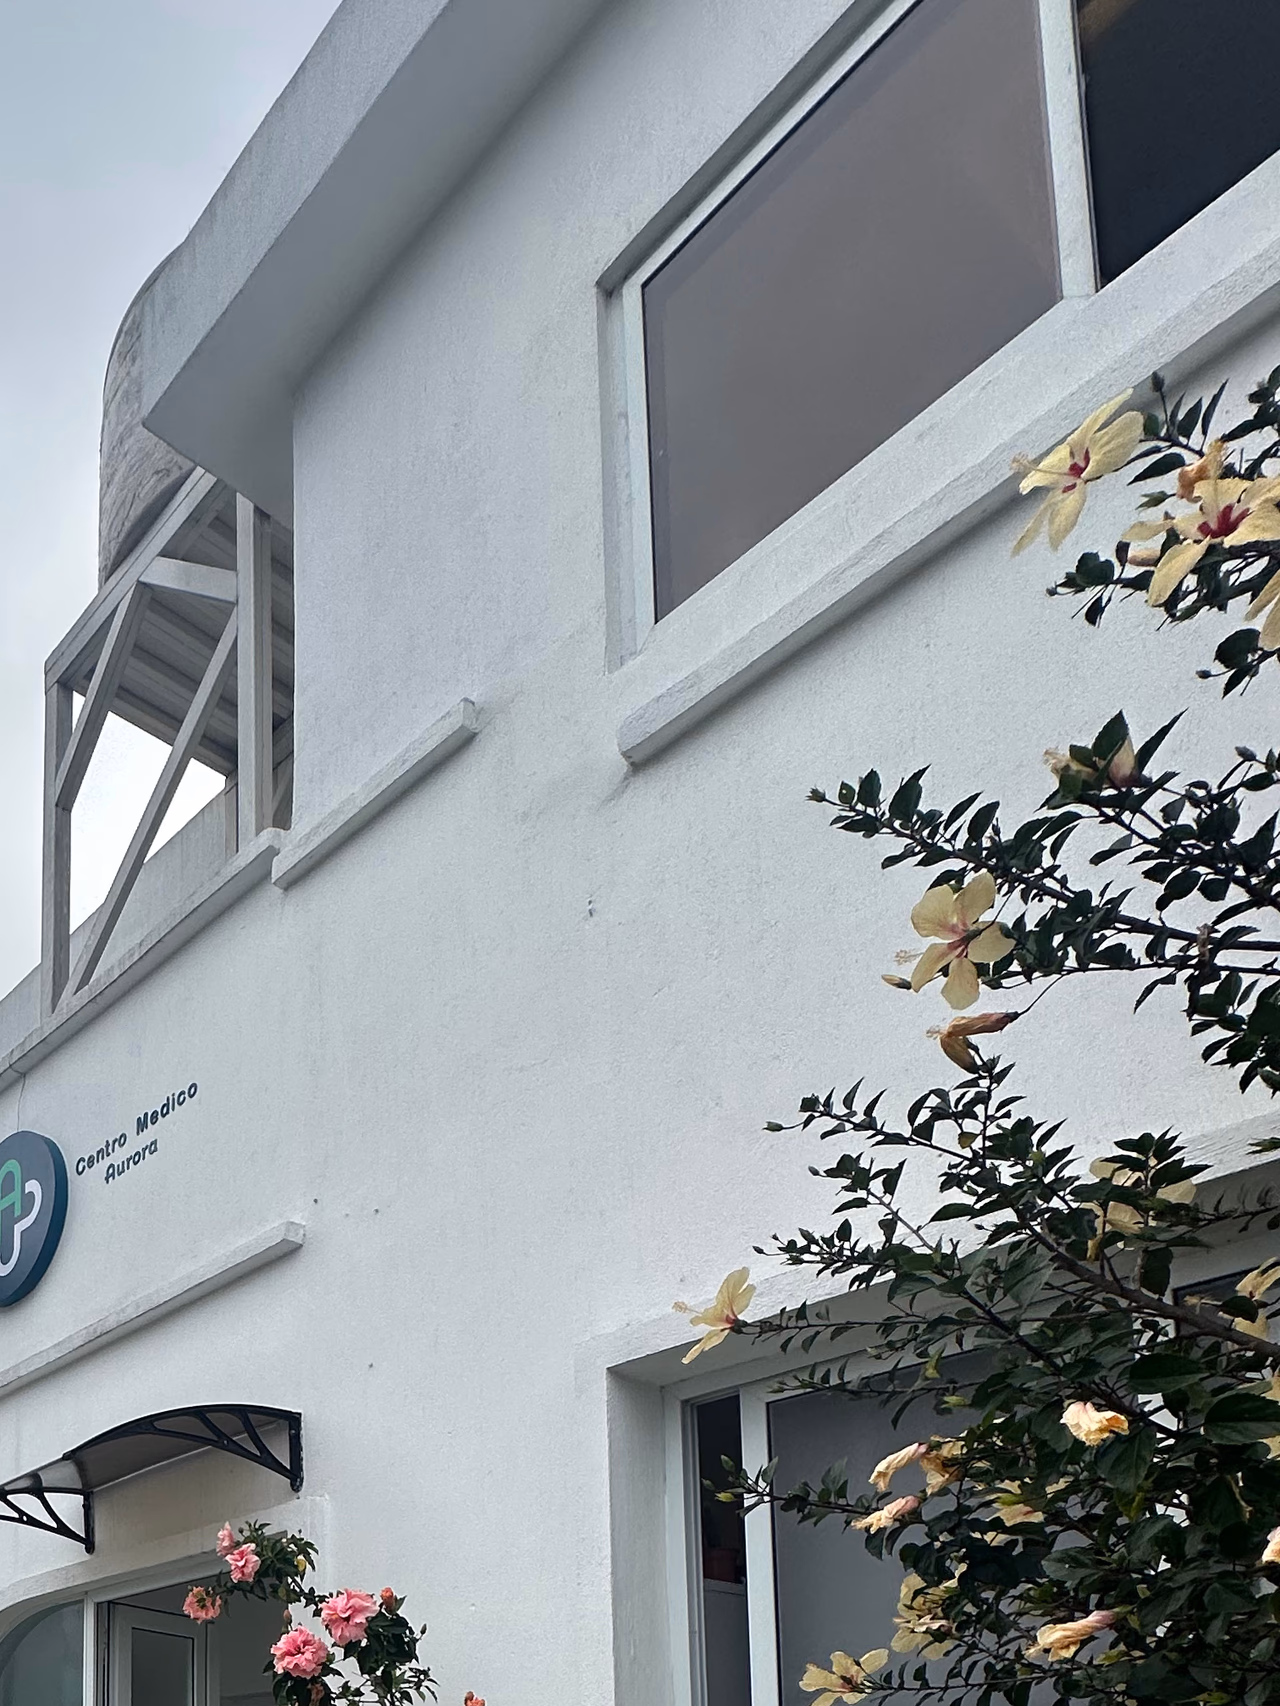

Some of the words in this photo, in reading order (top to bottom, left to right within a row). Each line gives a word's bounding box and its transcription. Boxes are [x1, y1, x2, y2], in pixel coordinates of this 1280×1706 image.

[75, 1132, 128, 1176] Centro
[136, 1082, 198, 1136] Medico
[104, 1138, 159, 1185] Aurora
